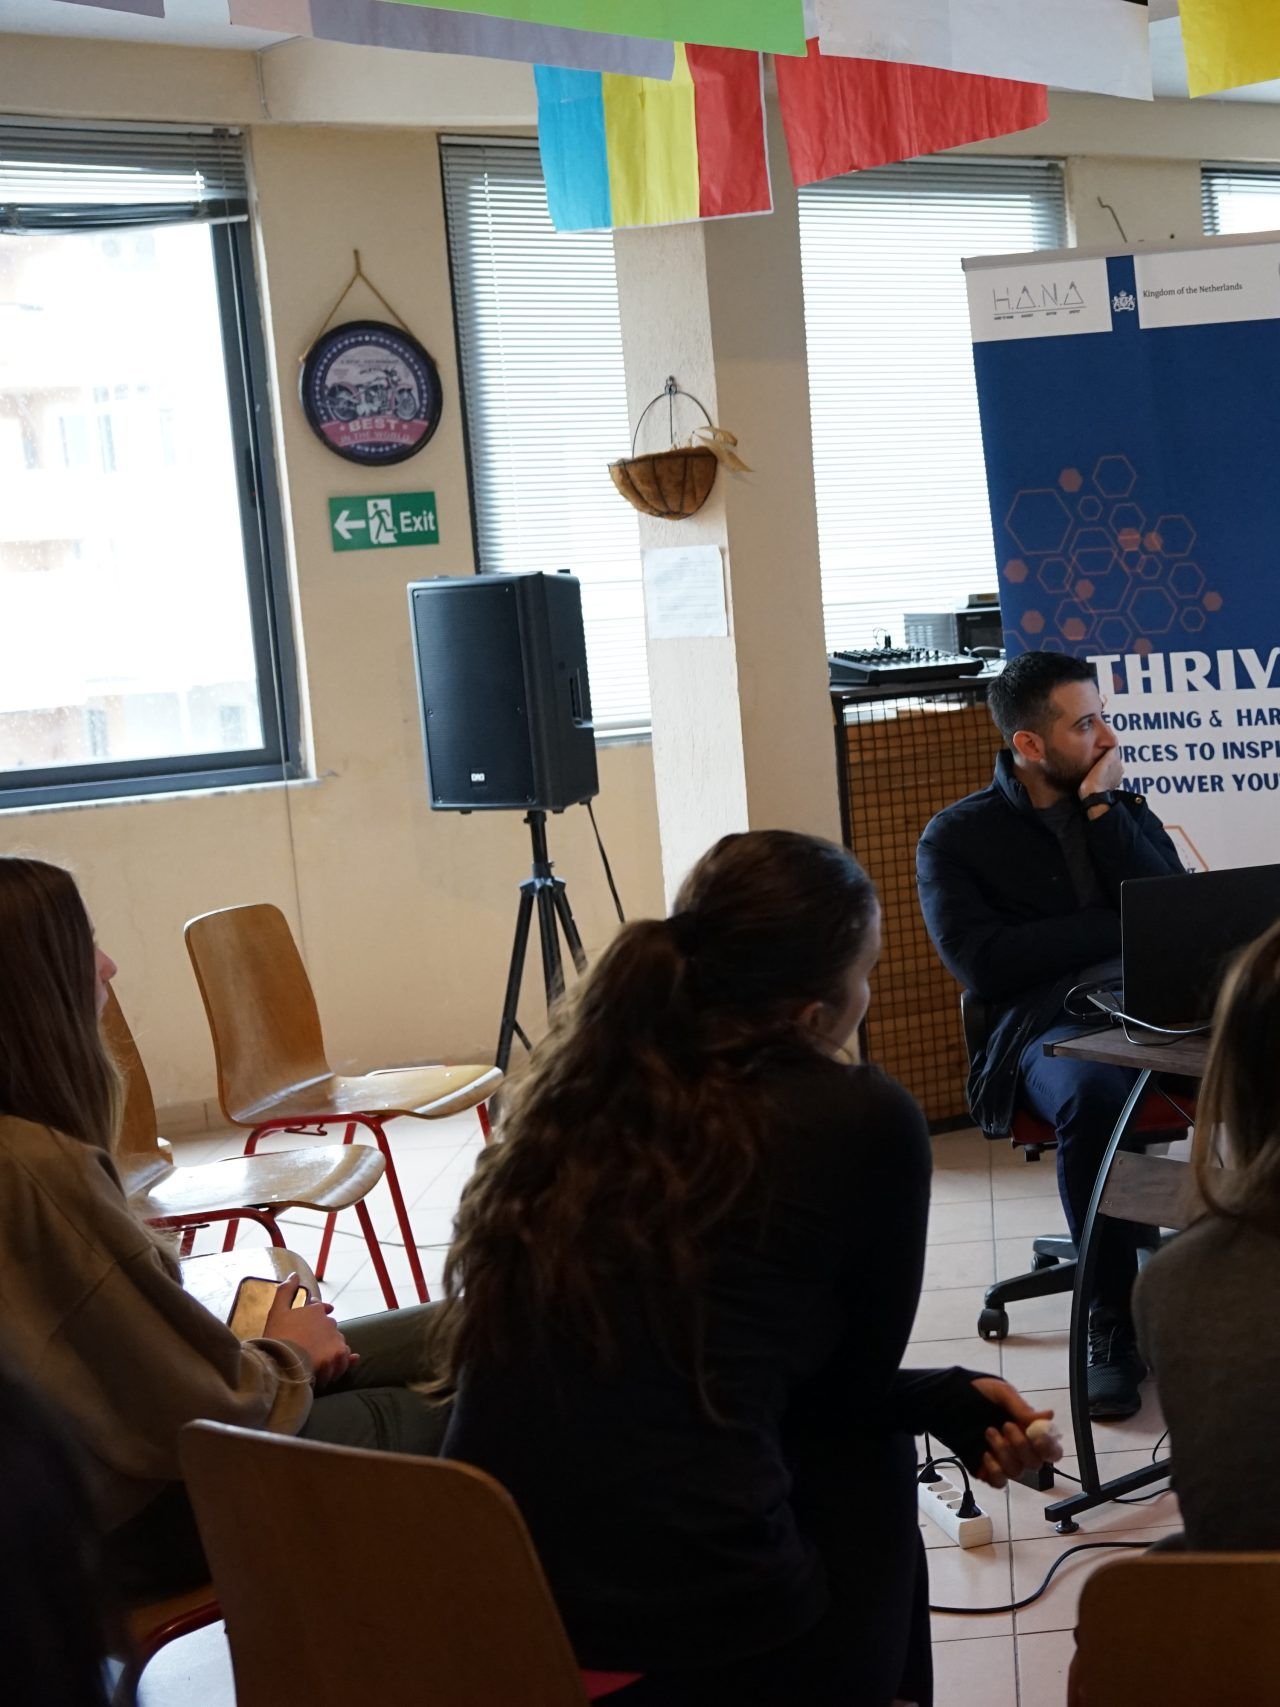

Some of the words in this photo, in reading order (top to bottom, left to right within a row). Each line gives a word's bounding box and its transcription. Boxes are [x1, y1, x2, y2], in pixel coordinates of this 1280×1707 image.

[1143, 288, 1176, 299] Kingdom
[1176, 287, 1185, 295] of
[1185, 286, 1198, 294] the
[1199, 282, 1243, 293] Netherlands
[349, 418, 398, 432] BEST
[400, 510, 436, 533] Exit
[1210, 709, 1222, 727] &
[1118, 744, 1179, 763] RCES
[1185, 742, 1215, 761] TO
